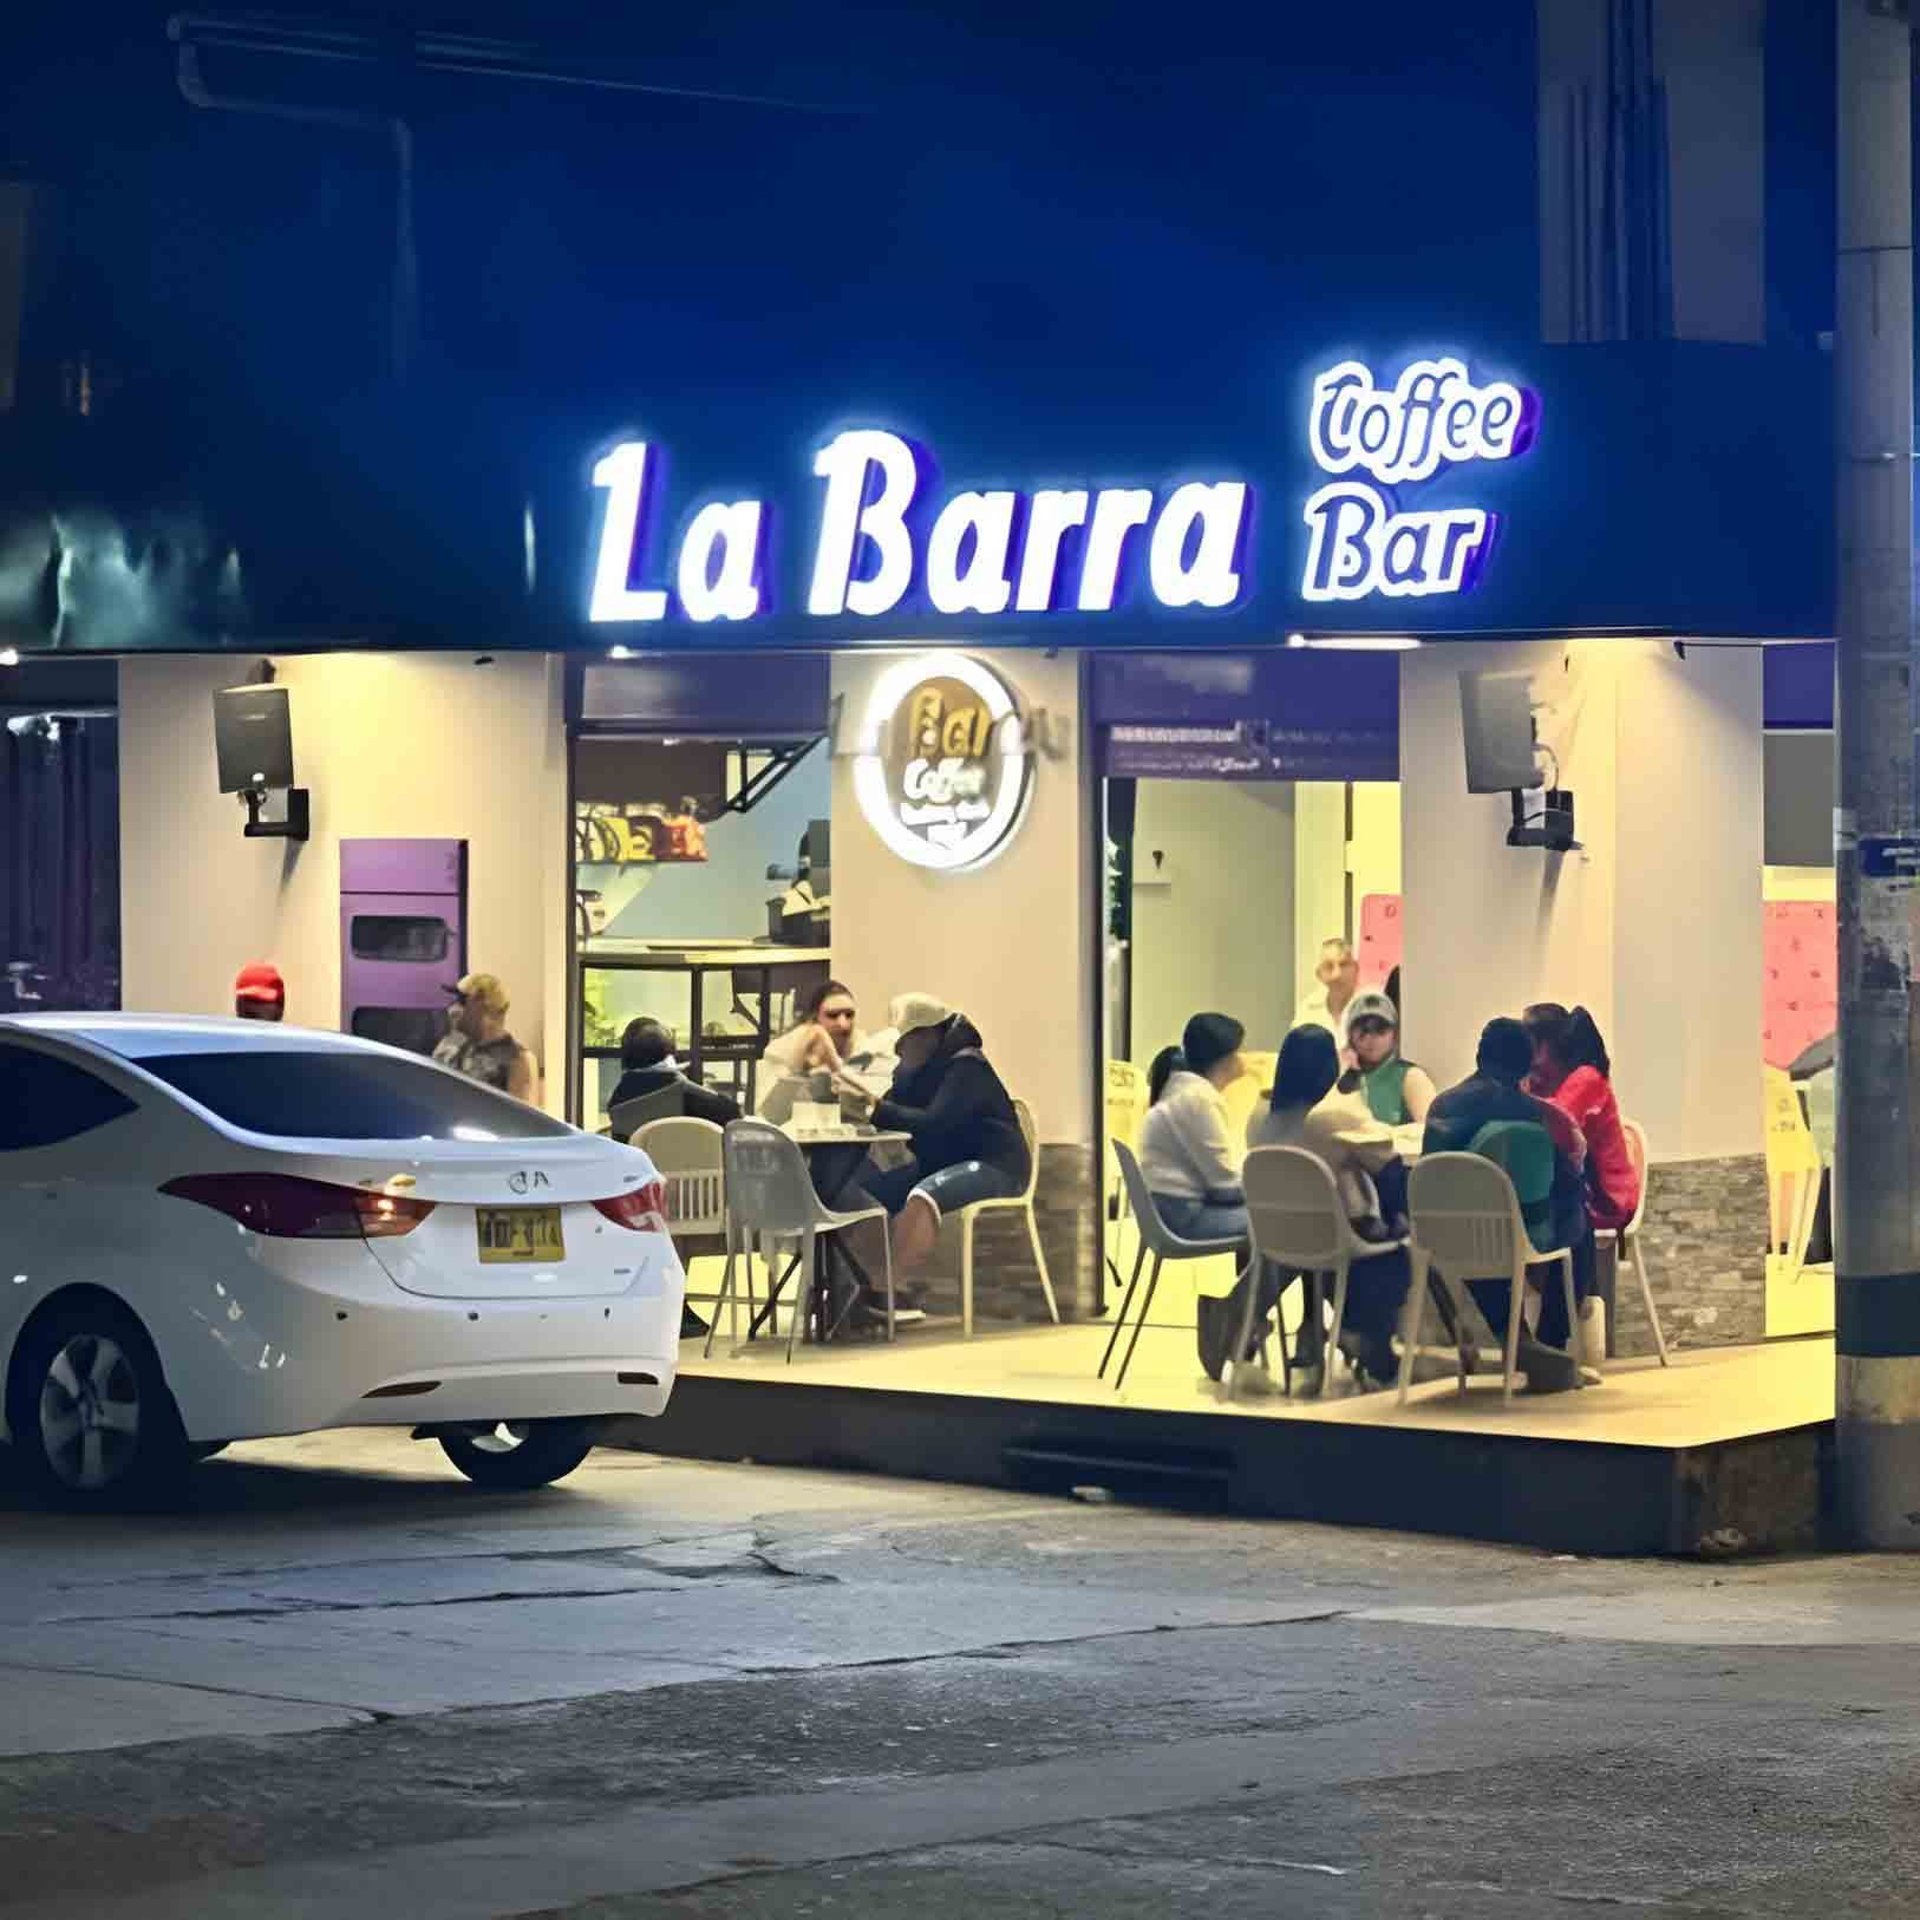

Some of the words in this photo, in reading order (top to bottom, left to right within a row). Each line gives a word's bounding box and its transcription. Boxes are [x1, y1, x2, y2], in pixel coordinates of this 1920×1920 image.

[1309, 359, 1523, 484] Coffee
[589, 443, 762, 623] La
[809, 430, 1247, 616] Barra
[1303, 481, 1488, 601] Bar
